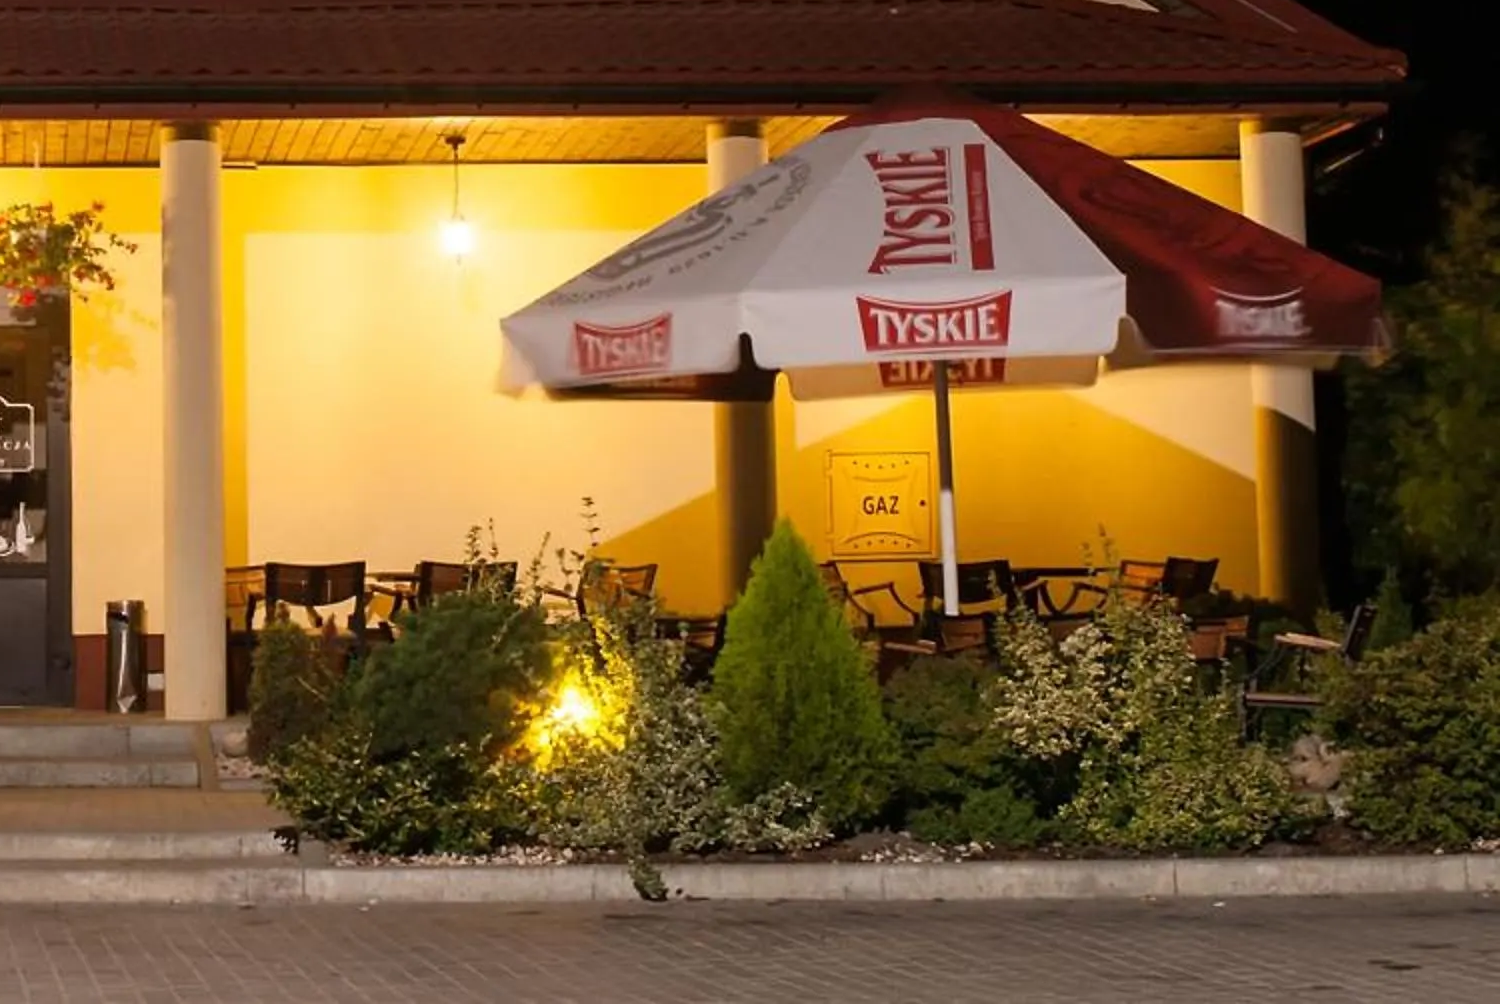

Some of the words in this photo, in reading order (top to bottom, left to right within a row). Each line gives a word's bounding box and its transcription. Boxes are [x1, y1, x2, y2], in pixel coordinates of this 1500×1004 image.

[866, 148, 955, 274] TYSKIE
[870, 303, 999, 345] TYSKIE
[863, 496, 899, 515] GAZ
